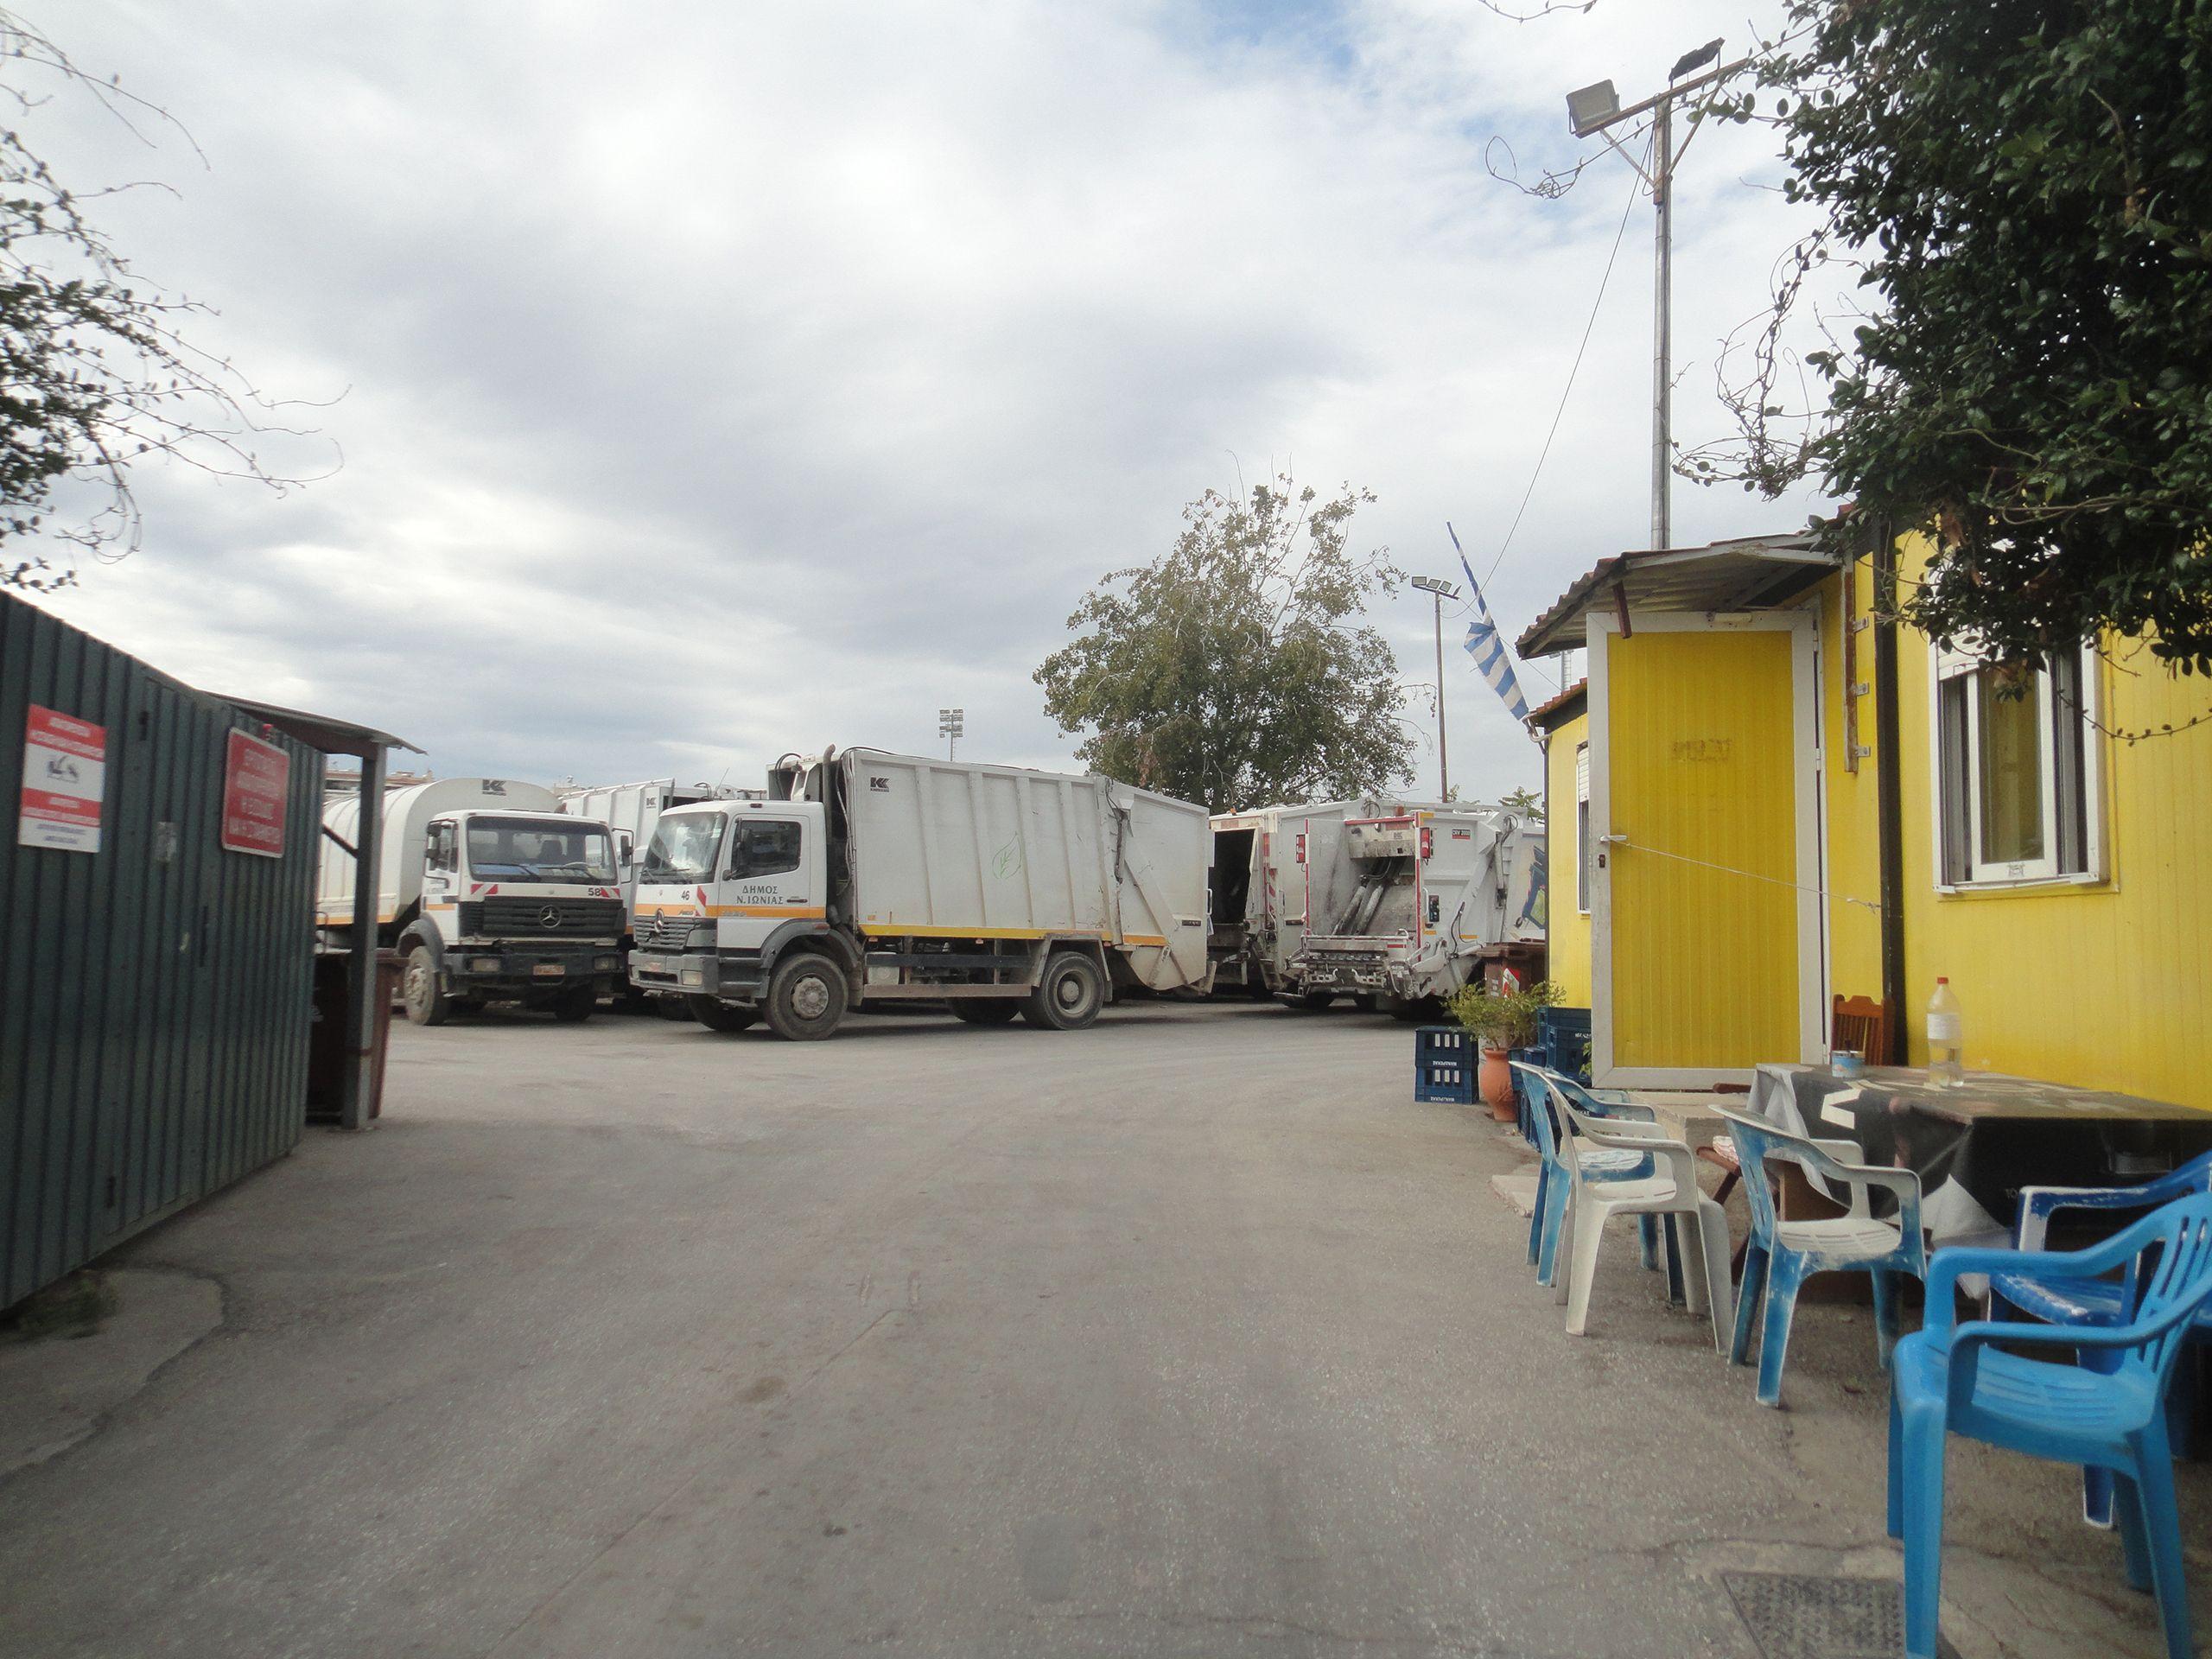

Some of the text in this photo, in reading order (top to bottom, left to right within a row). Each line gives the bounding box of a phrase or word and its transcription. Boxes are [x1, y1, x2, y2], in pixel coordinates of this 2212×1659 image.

[588, 887, 601, 896] 58
[742, 885, 778, 894] ΔΗΜΟΣ
[681, 890, 690, 900] 46
